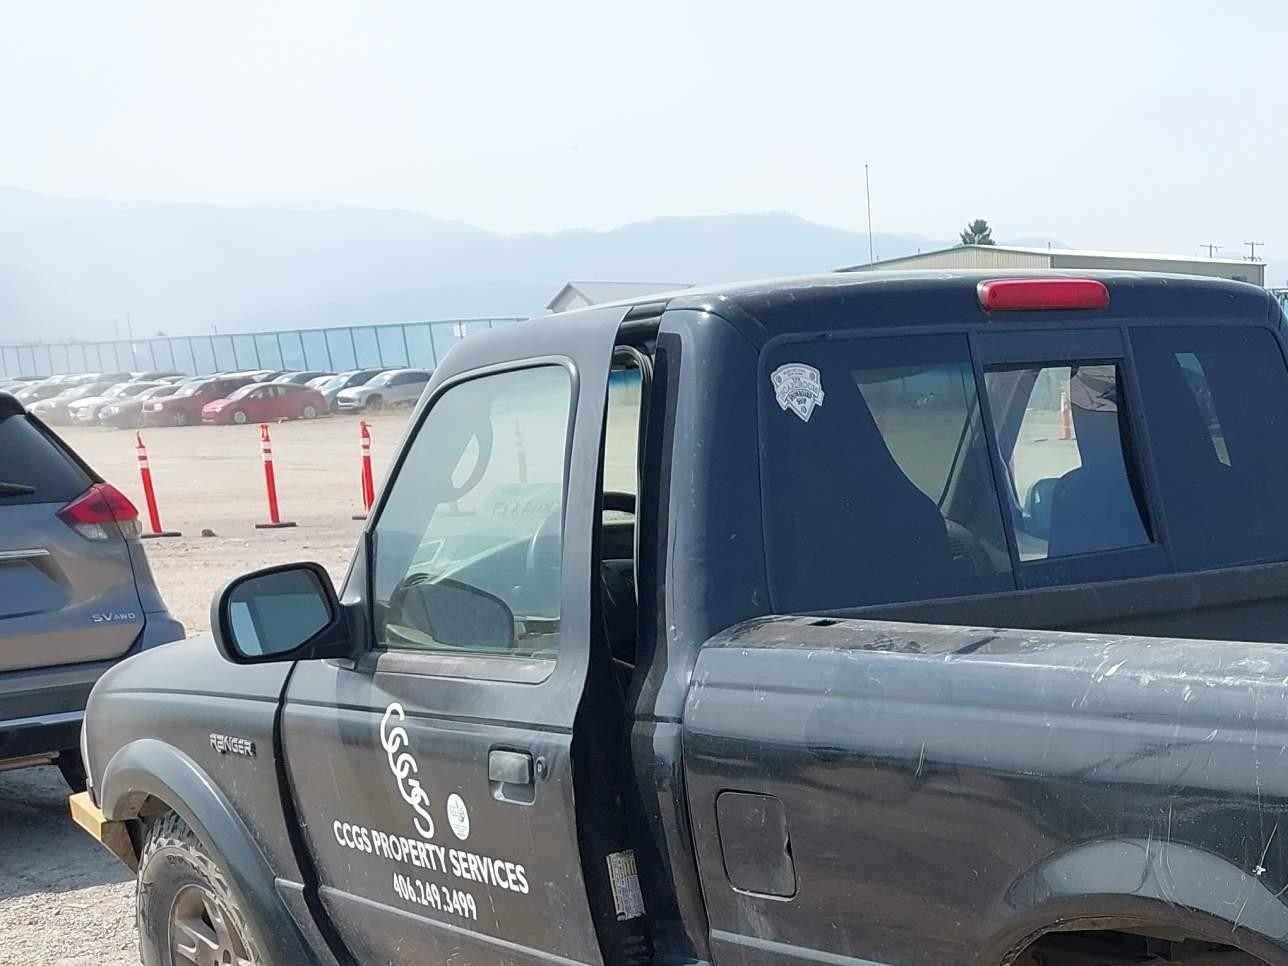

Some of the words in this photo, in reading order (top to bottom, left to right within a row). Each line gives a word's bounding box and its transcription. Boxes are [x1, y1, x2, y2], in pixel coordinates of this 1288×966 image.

[92, 612, 113, 623] SV
[113, 612, 136, 621] AWD
[333, 820, 373, 854] CCGS
[371, 829, 448, 873] PROPERTY
[449, 848, 529, 895] SERVICES
[393, 872, 478, 921] 406.249.3499
